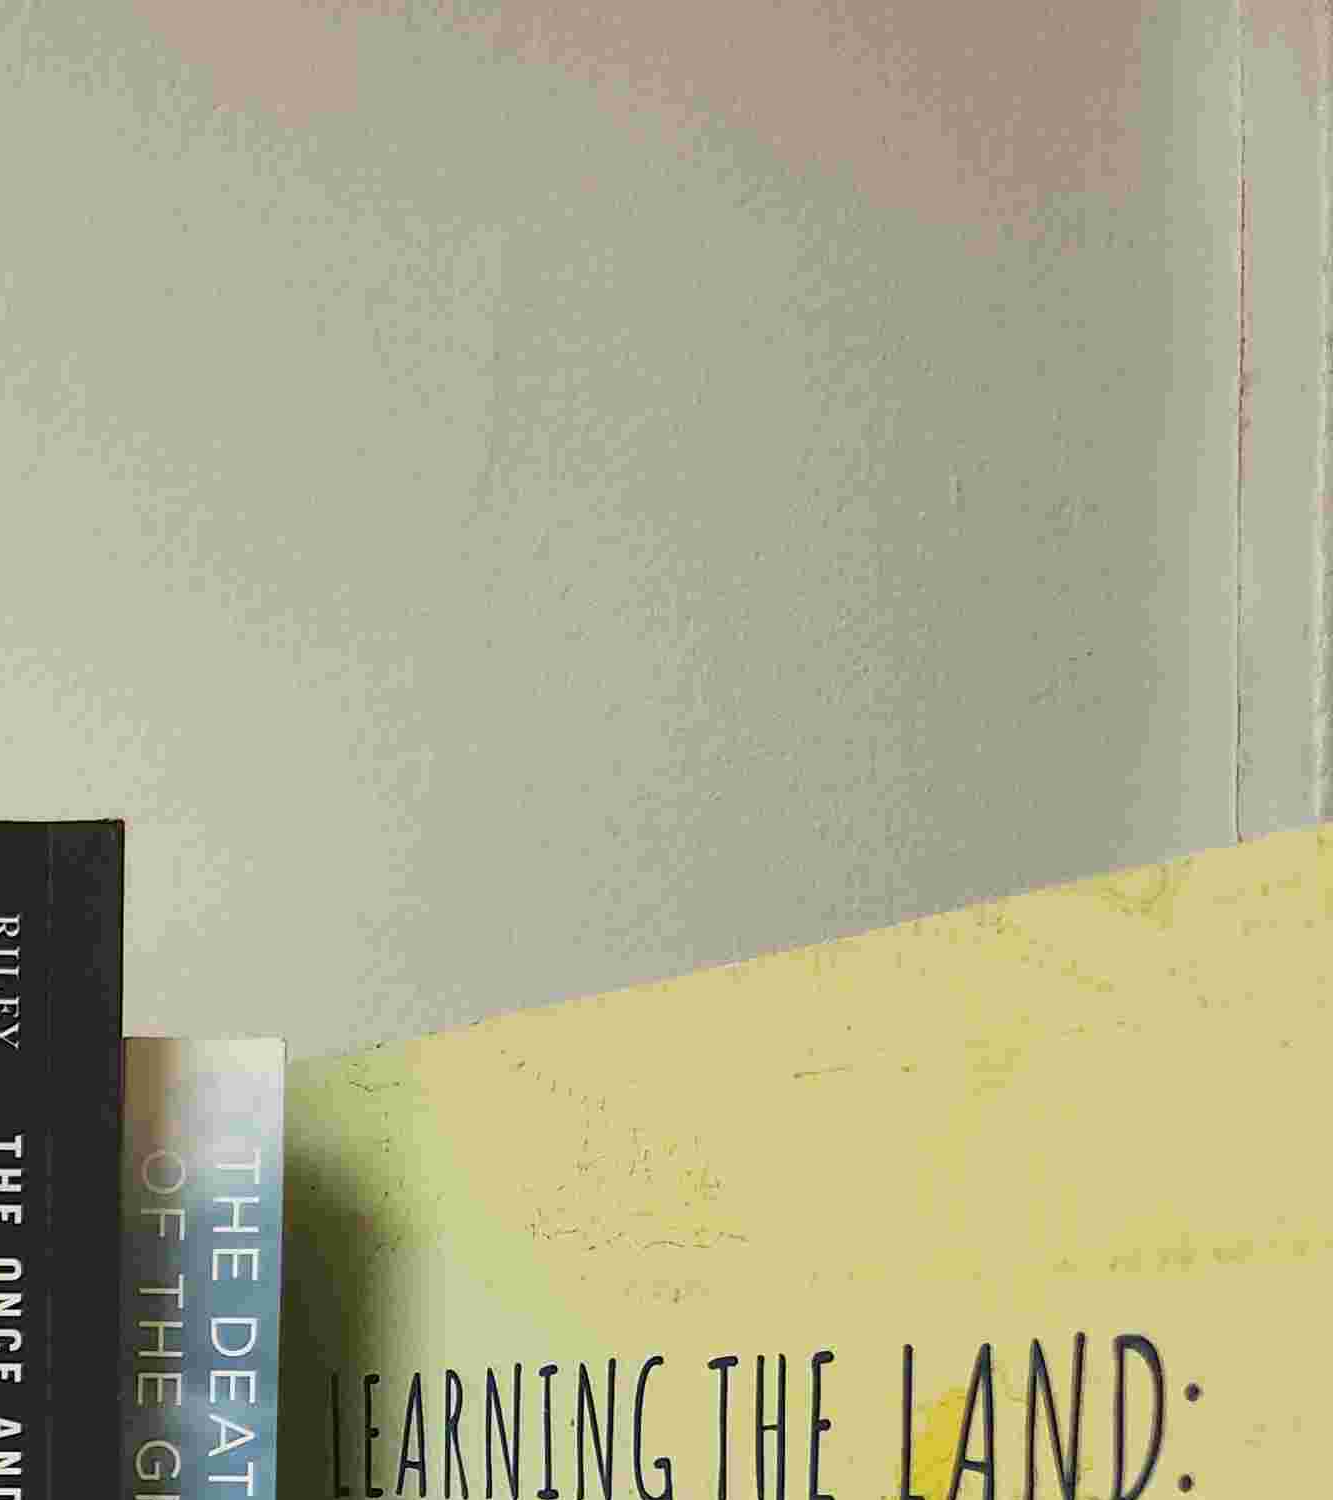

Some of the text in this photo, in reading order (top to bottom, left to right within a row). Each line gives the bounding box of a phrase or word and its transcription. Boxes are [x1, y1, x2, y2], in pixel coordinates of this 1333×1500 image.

[140, 1149, 185, 1240] OF
[213, 1150, 261, 1282] THE
[138, 1276, 183, 1407] THE
